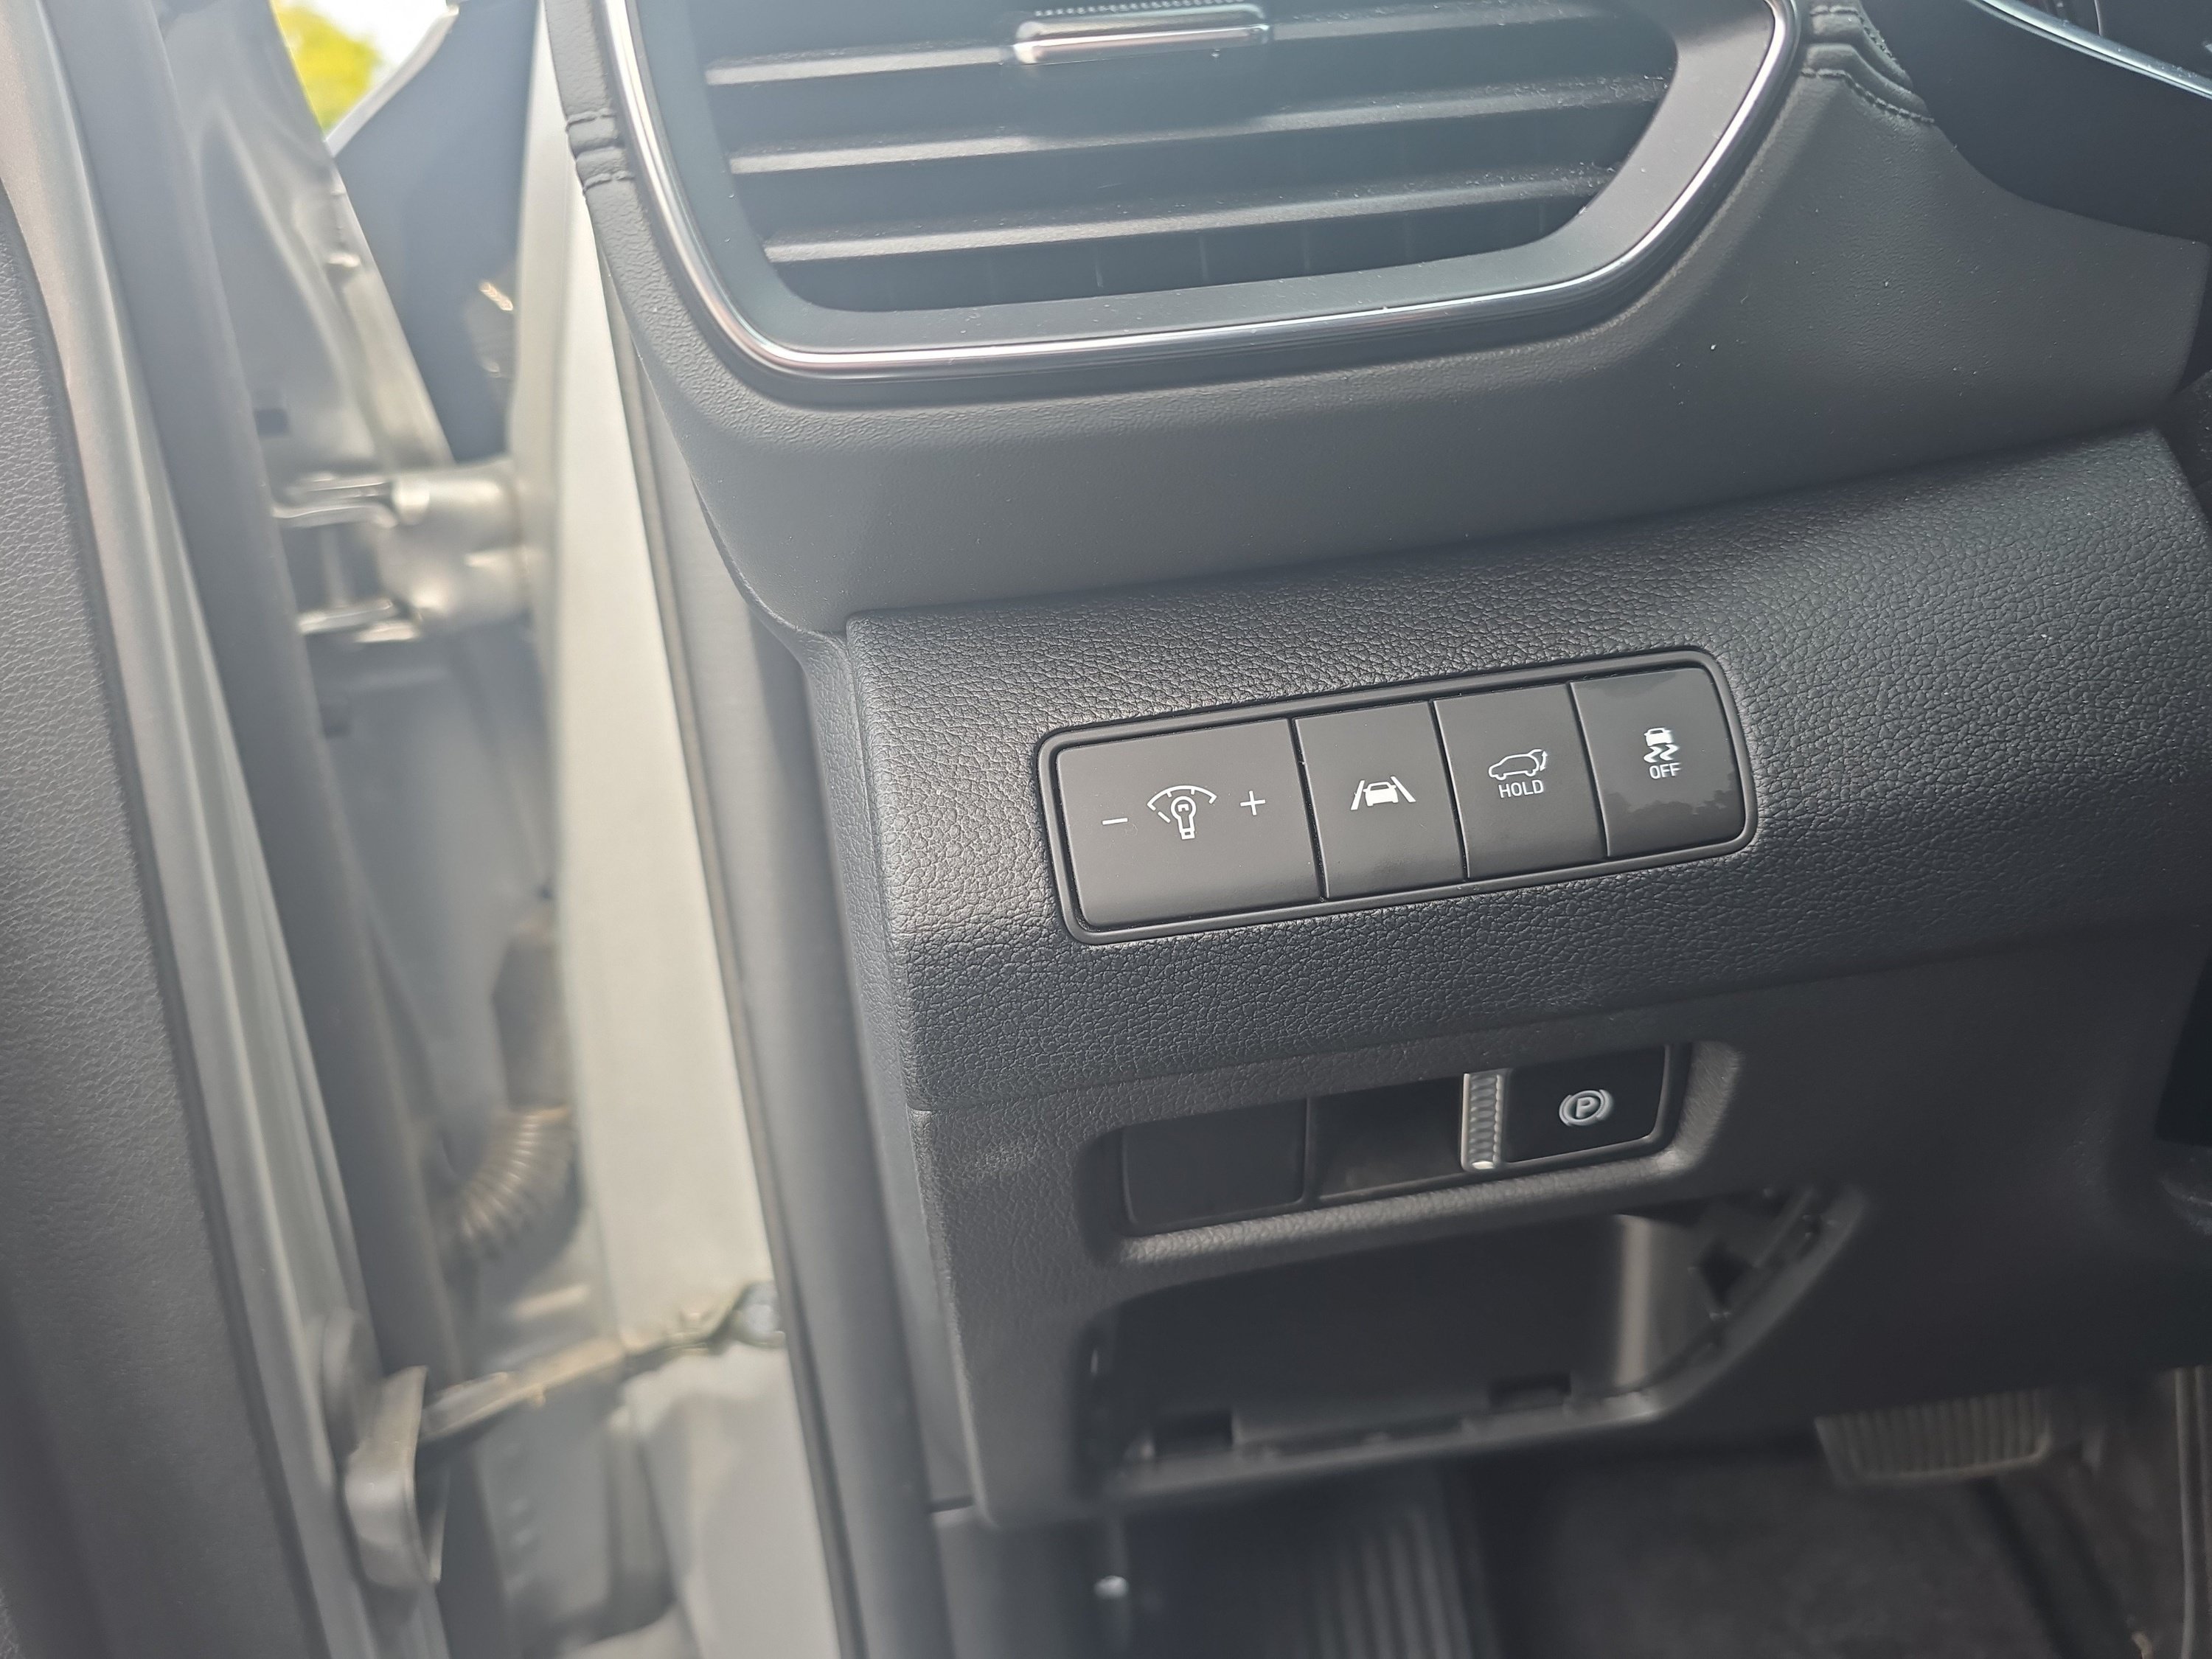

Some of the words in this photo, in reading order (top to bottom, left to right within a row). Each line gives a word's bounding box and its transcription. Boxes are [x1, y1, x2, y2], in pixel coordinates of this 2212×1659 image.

[1649, 762, 1682, 779] OFF
[1498, 779, 1544, 799] HOLD
[1575, 1096, 1599, 1119] P
